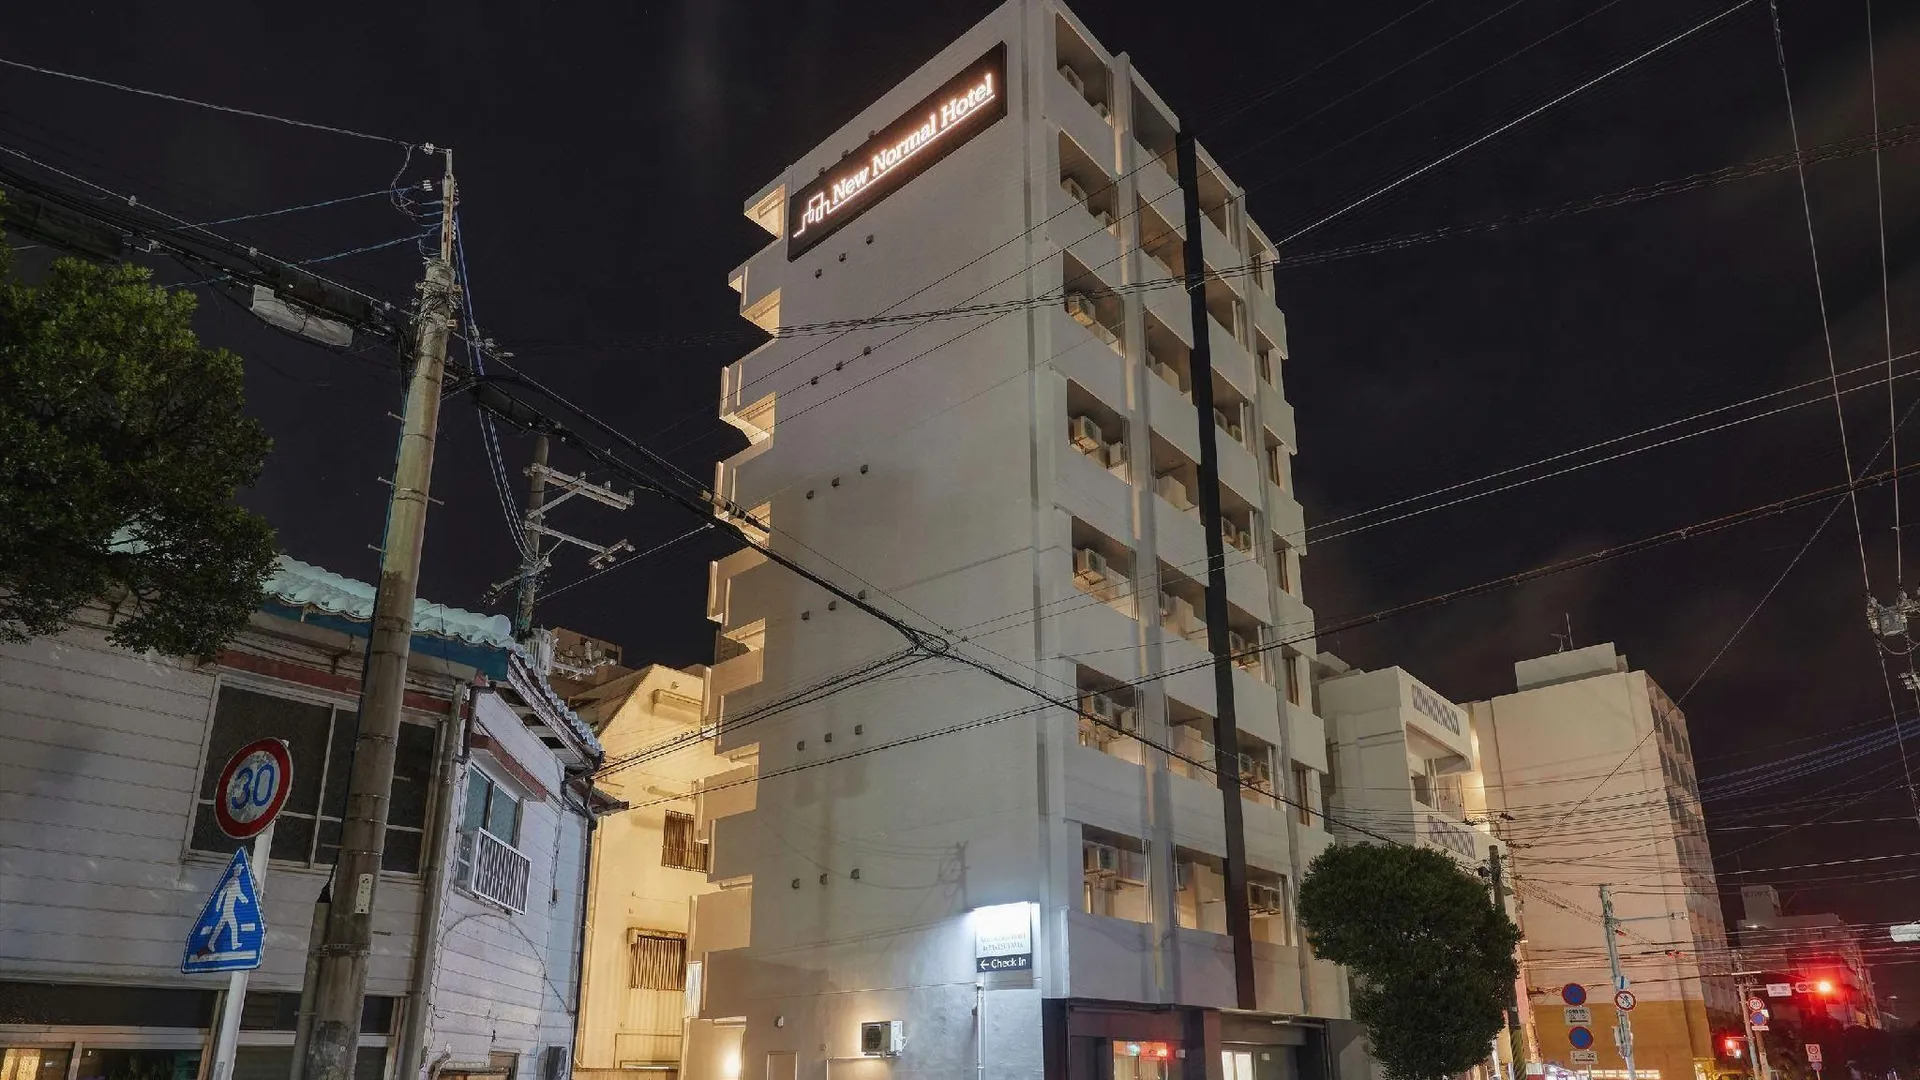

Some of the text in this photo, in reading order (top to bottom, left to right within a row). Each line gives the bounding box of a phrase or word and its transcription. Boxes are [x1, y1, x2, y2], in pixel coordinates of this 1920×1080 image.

[832, 72, 994, 204] New Normal Hotel
[231, 763, 275, 810] 30
[991, 957, 1027, 969] Check In
